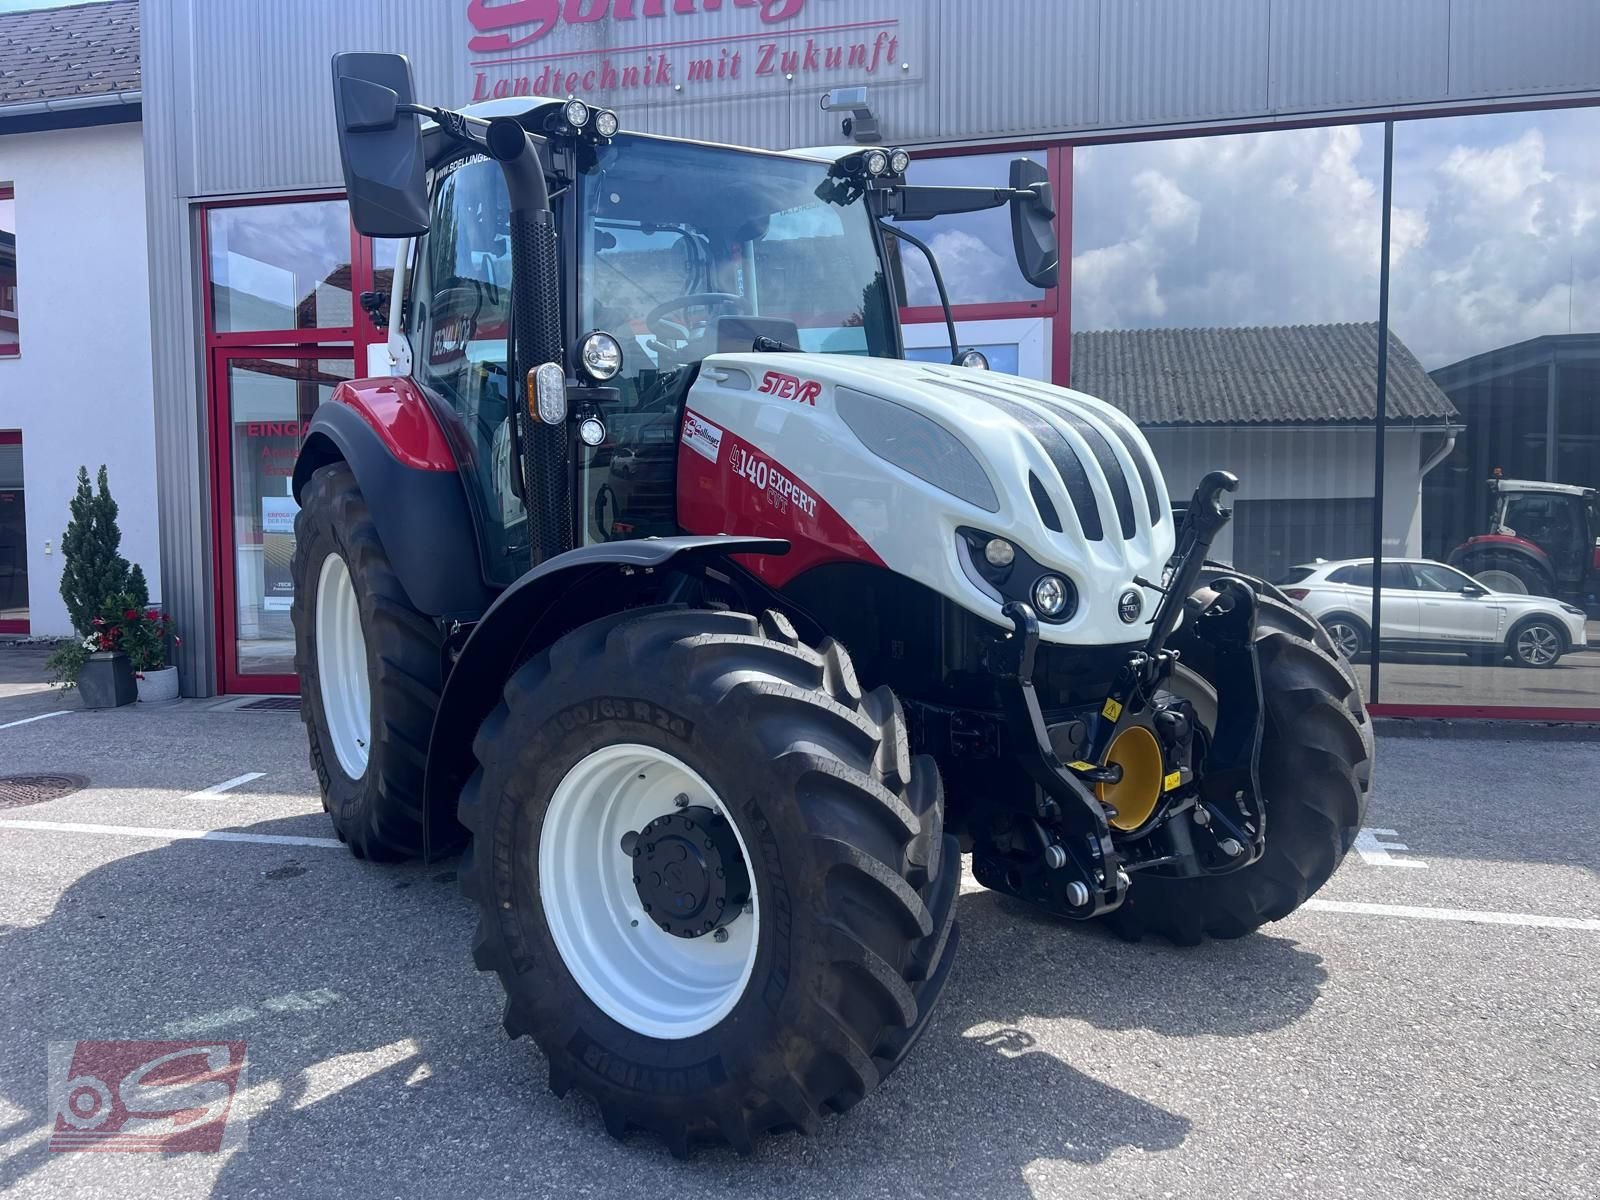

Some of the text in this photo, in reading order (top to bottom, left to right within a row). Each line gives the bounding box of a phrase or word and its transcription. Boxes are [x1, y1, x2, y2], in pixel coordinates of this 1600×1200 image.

[472, 31, 898, 100] Landtechnik mit Zukunft
[757, 370, 822, 407] STEYR
[729, 444, 816, 517] 4140 EXPERT
[767, 487, 788, 515] CVT
